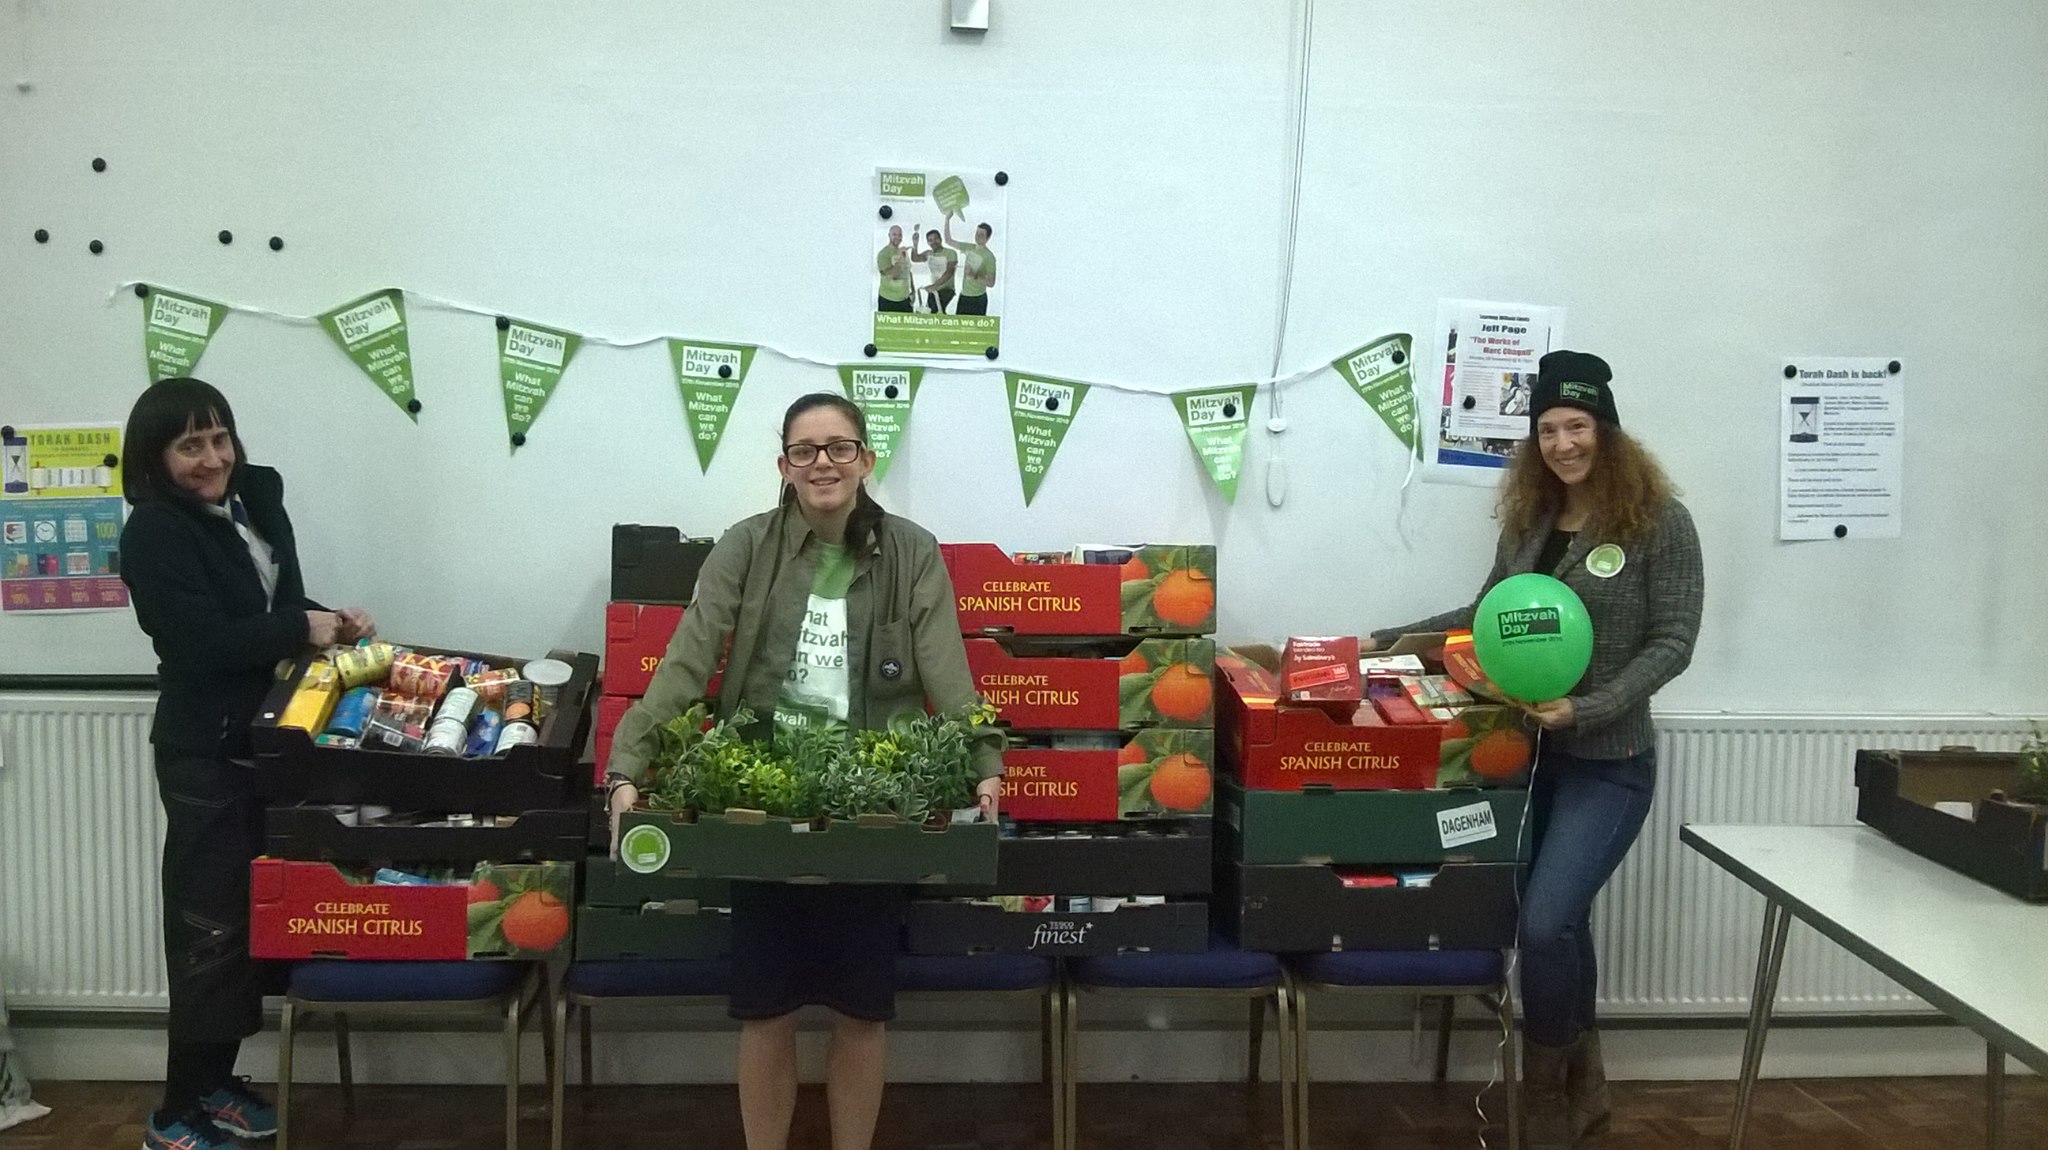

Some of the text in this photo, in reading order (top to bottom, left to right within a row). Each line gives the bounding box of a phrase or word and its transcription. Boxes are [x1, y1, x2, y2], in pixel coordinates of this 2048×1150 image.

[883, 174, 923, 185] Mitzvah
[883, 184, 903, 194] Day
[156, 297, 208, 320] Mitzvah
[338, 296, 392, 329] Mitzvah
[154, 309, 180, 326] Day
[877, 314, 901, 324] What
[903, 315, 940, 326] Mitzvah
[941, 318, 959, 326] can
[977, 318, 995, 327] do?
[344, 322, 370, 339] Day
[1482, 323, 1527, 335] Jeff Page
[510, 328, 563, 351] Mitzvah
[159, 341, 186, 356] What
[368, 343, 396, 360] What
[509, 340, 535, 357] Day
[150, 349, 190, 367] Mitzvah
[367, 351, 407, 373] Mitzvah
[686, 349, 738, 364] Mitzvah
[1352, 339, 1401, 372] Mitzvah
[158, 363, 177, 375] can
[382, 364, 402, 377] can
[686, 361, 711, 374] Day
[1356, 364, 1381, 382] Day
[1799, 369, 1888, 379] Torah Dash is back!
[387, 374, 404, 386] we
[514, 372, 541, 386] What
[857, 373, 907, 385] Mitzvah
[392, 380, 410, 394] do?
[506, 380, 546, 397] Mitzvah
[857, 385, 881, 398] Day
[1020, 381, 1071, 400] Mitzvah
[1379, 384, 1406, 401] What
[1563, 382, 1598, 396] Mitzvah
[513, 393, 533, 404] can
[696, 391, 722, 402] What
[1563, 389, 1581, 399] Day
[688, 401, 729, 413] Mitzvah
[1019, 393, 1043, 409] Day
[1190, 396, 1240, 410] Mitzvah
[1377, 391, 1415, 413] Mitzvah
[514, 403, 529, 413] we
[1391, 405, 1409, 417] can
[511, 411, 532, 423] do?
[698, 413, 717, 422] can
[868, 414, 894, 423] What
[1190, 409, 1216, 422] Day
[1395, 413, 1411, 424] we
[699, 422, 715, 431] we
[1026, 425, 1053, 436] What
[31, 432, 111, 447] TORAH DASH
[698, 430, 718, 441] do?
[871, 433, 890, 441] can
[1018, 434, 1057, 448] Mitzvah
[1206, 435, 1233, 446] What
[1027, 446, 1045, 456] can
[1202, 445, 1241, 456] Mitzvah
[1027, 455, 1043, 464] we
[1213, 455, 1232, 464] can
[1025, 463, 1045, 474] do?
[1217, 471, 1237, 482] do?
[983, 581, 1051, 593] CELEBRATE
[959, 596, 1082, 612] SPANISH CITRUS
[1501, 609, 1558, 625] Mitzvah
[1502, 623, 1529, 636] Day
[815, 654, 844, 667] we
[981, 675, 1049, 686] CELEBRATE
[1025, 690, 1080, 706] CITRUS
[1304, 742, 1371, 753] CELEBRATE
[1280, 755, 1400, 770] SPANISH CITRUS
[1023, 781, 1079, 797] CITRUS
[1441, 810, 1492, 836] DAGENHAM
[315, 902, 390, 915] CELEBRATE
[288, 918, 423, 936] SPANISH CITRUS
[1027, 923, 1088, 950] finest
